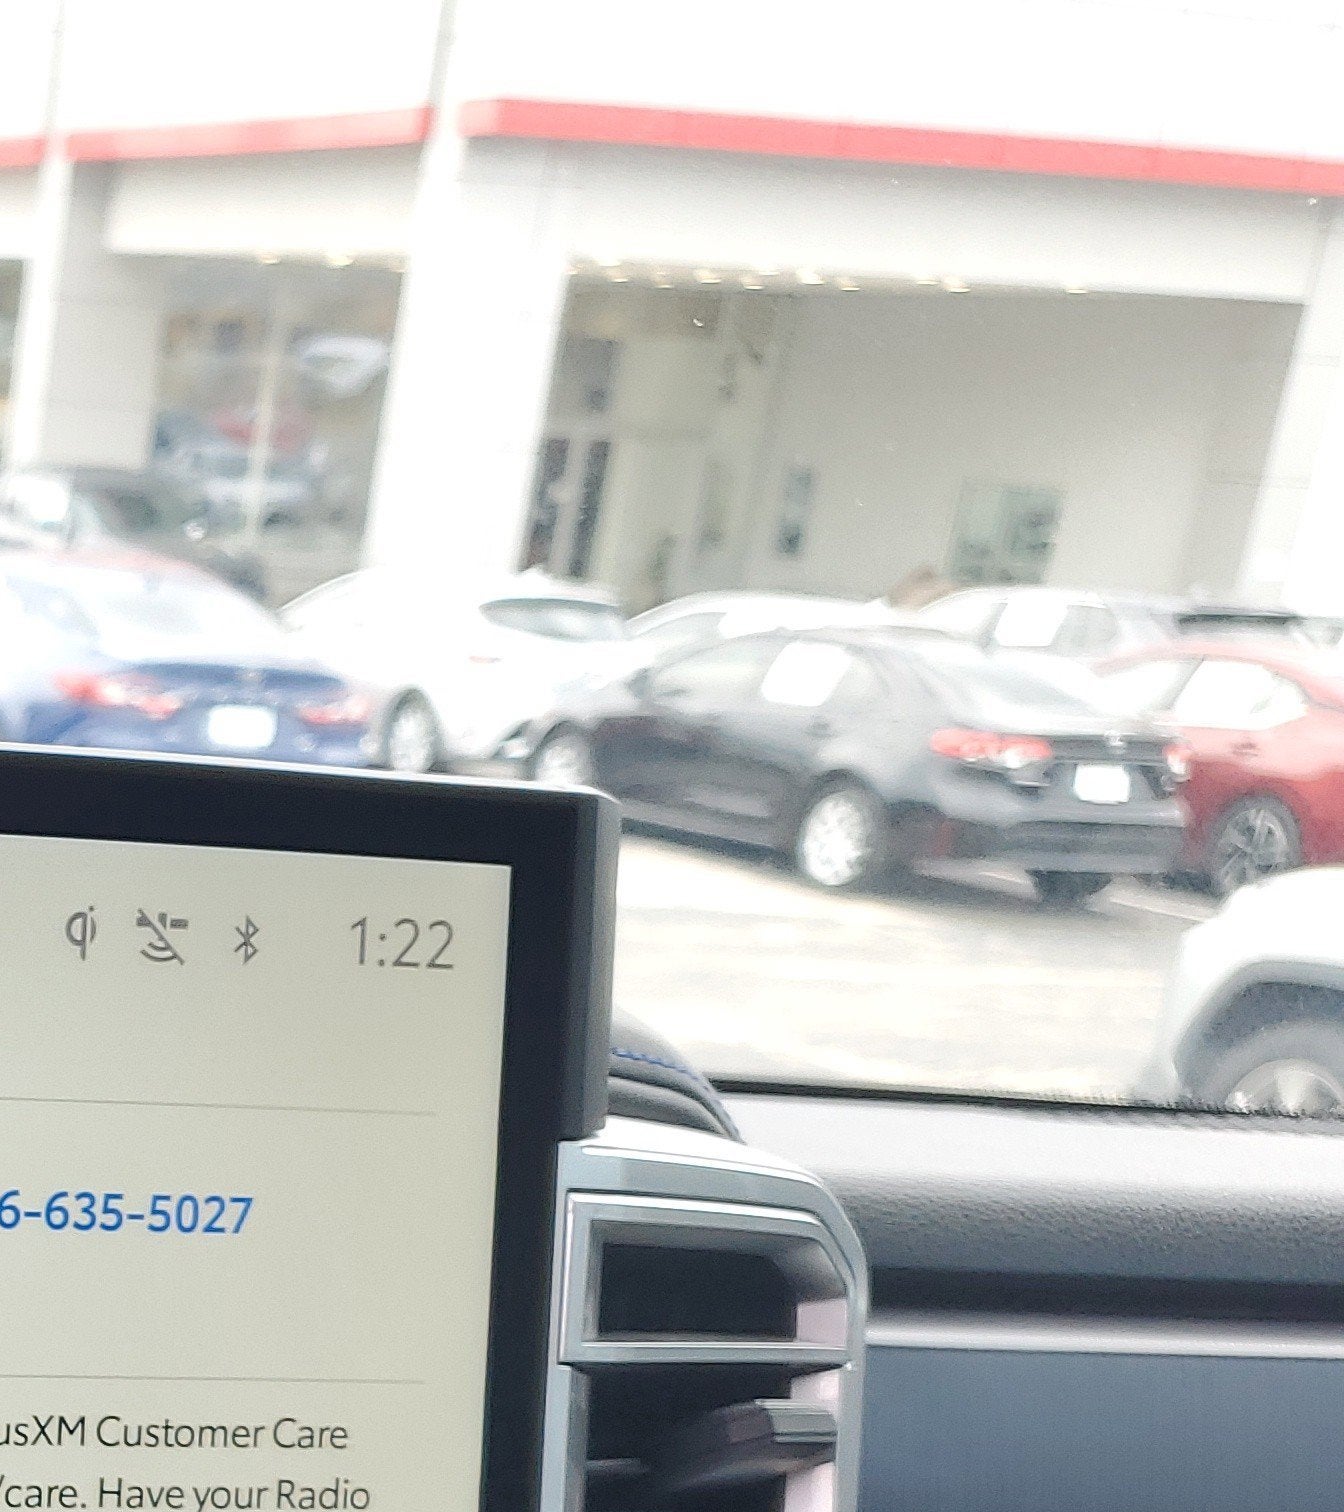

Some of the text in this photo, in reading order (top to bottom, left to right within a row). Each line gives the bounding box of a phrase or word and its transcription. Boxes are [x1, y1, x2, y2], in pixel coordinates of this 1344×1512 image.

[350, 916, 454, 970] 1:22
[96, 1415, 266, 1449] Customer
[272, 1417, 349, 1450] Care
[98, 1477, 185, 1510] Have
[276, 1477, 371, 1510] Radio
